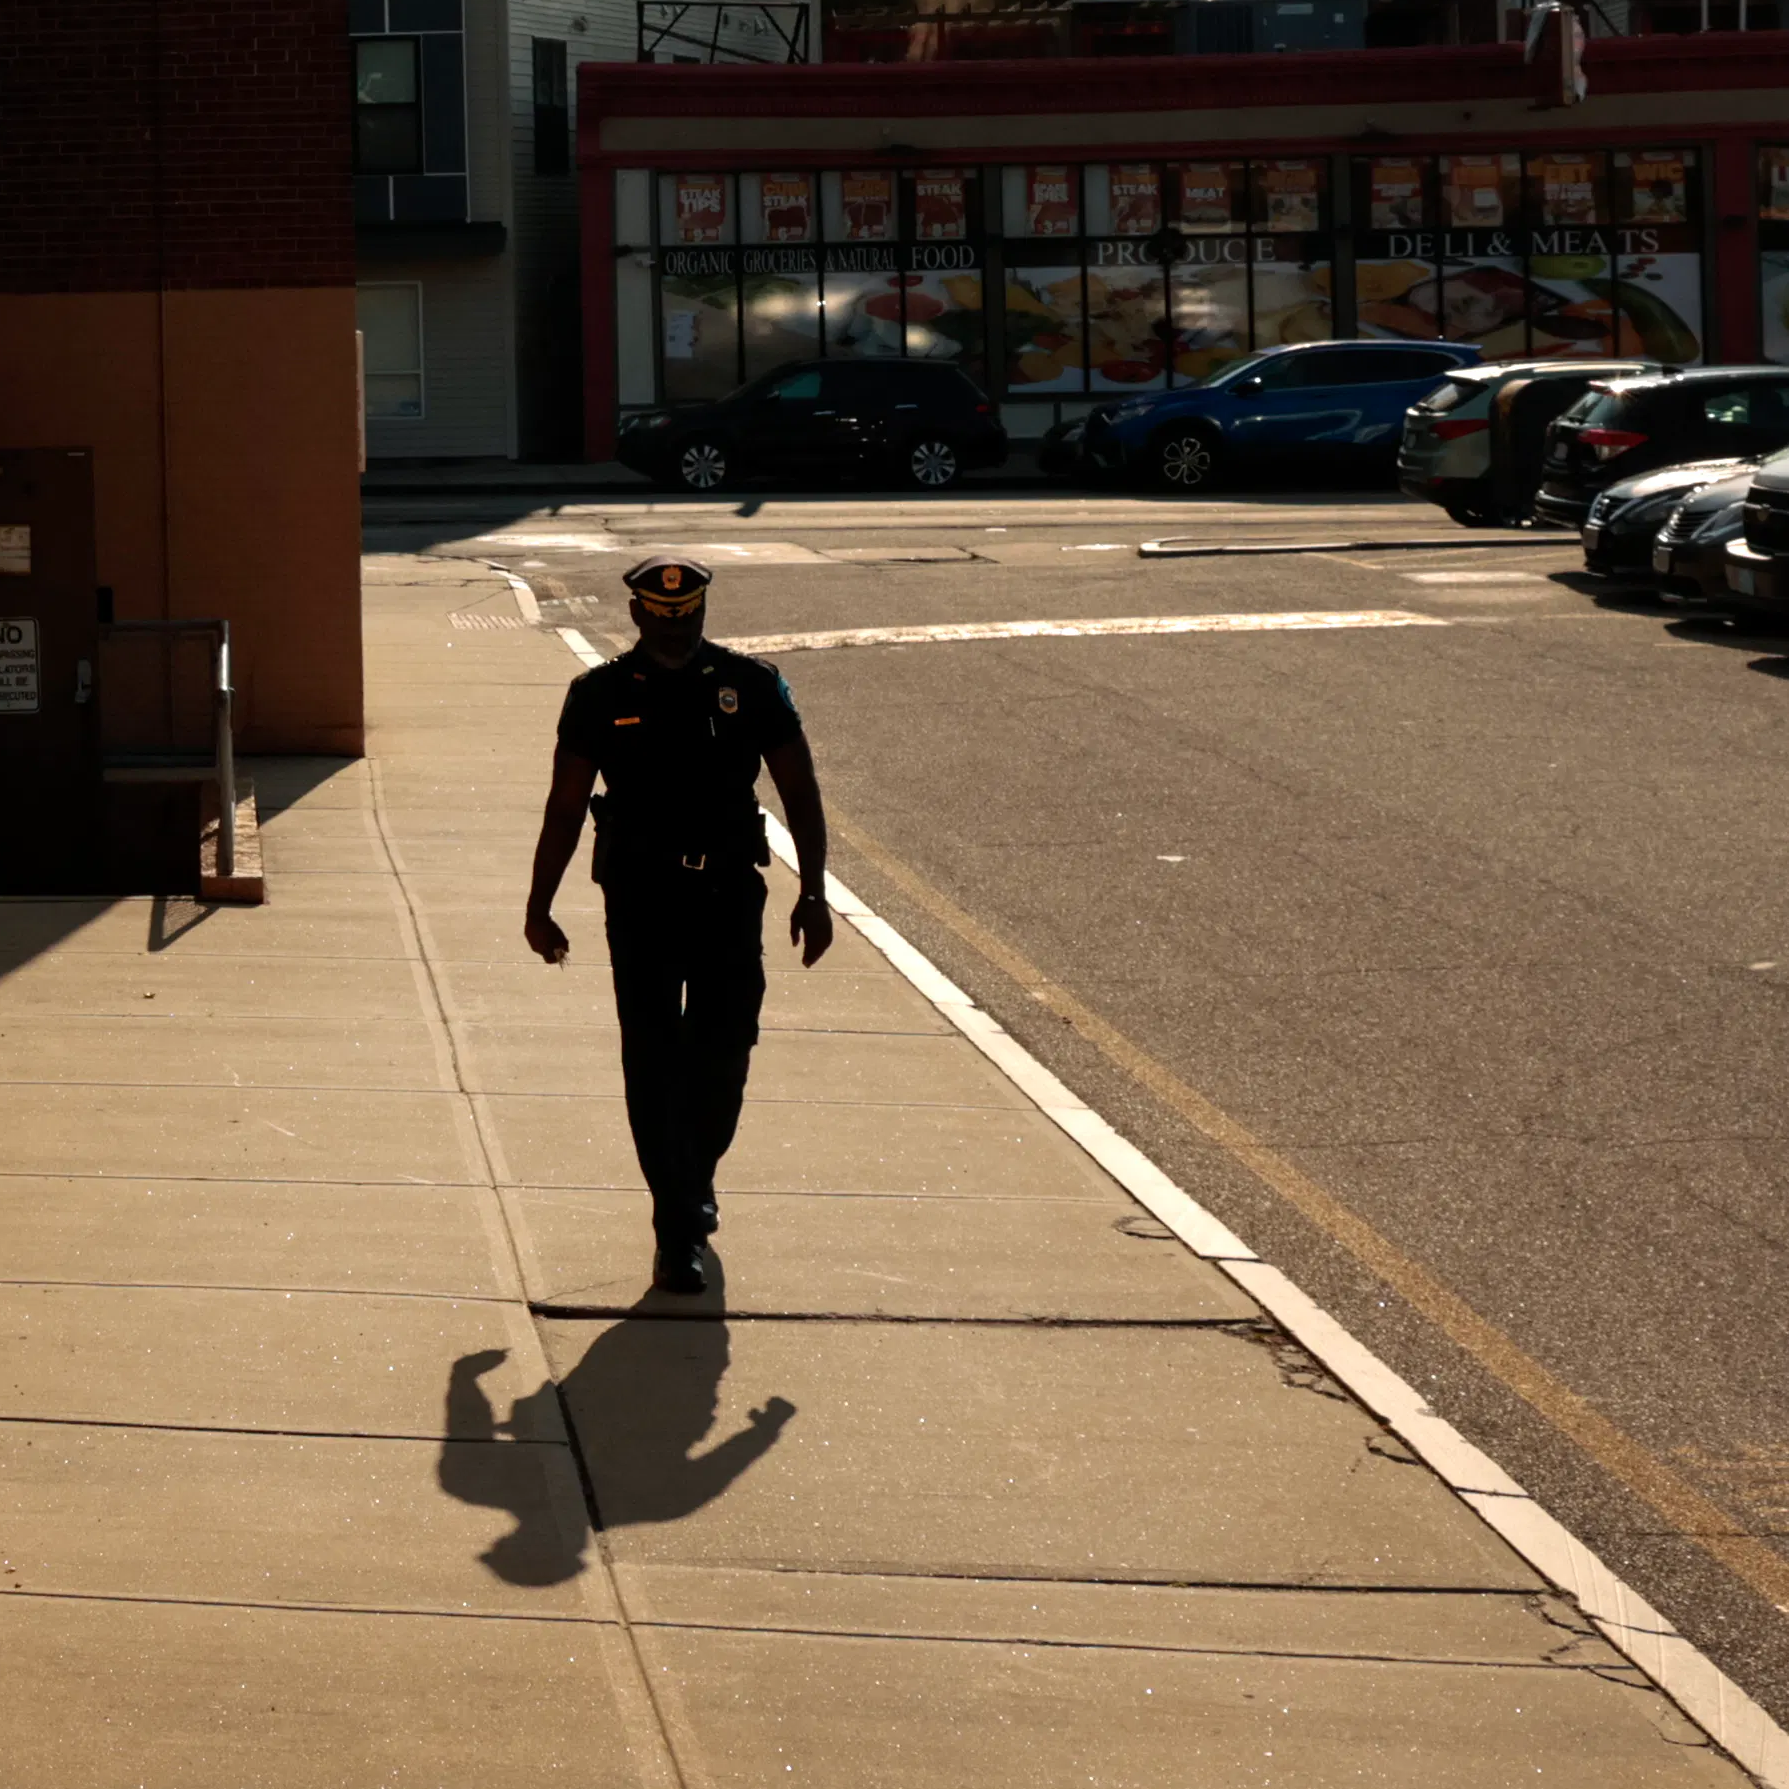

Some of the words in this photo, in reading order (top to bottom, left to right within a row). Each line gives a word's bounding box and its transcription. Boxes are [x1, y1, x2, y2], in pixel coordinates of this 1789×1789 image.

[680, 188, 721, 200] STEAK
[916, 184, 962, 196] STEAK
[1111, 184, 1158, 196] STEAK
[1185, 187, 1225, 198] MEAT
[682, 198, 721, 213] TIPS
[763, 195, 808, 207] STEAK
[1389, 231, 1476, 258] DELI
[1487, 231, 1513, 255] &
[1530, 228, 1660, 254] MEATS
[665, 251, 735, 274] ORGANIC
[743, 248, 817, 273] GROCERIES
[824, 248, 836, 271] &
[838, 248, 899, 271] NATURAL
[911, 245, 975, 269] FOOD
[15, 676, 30, 686] BE
